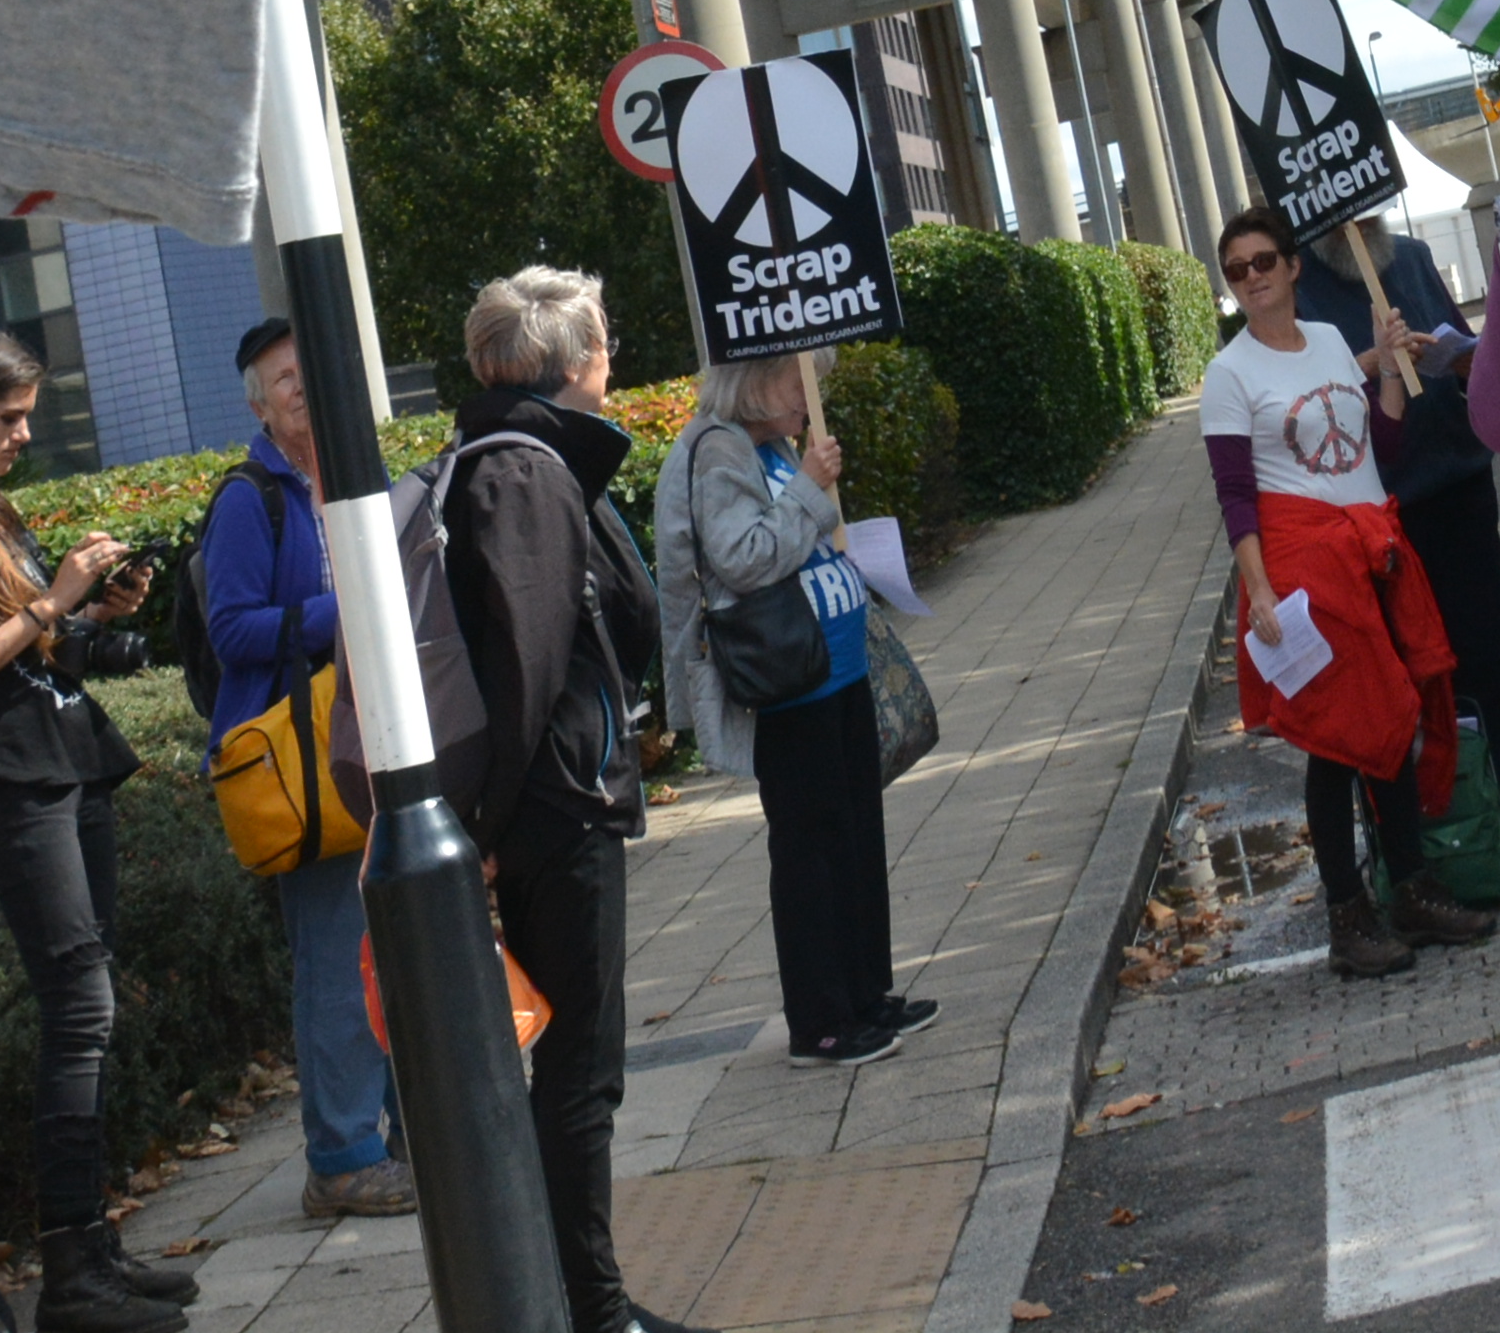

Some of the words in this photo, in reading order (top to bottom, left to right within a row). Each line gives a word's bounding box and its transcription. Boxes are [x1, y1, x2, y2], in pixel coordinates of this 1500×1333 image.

[623, 90, 666, 145] 2
[1278, 119, 1360, 184] Scrap
[1278, 145, 1391, 228] Trident
[727, 243, 852, 293] Scrap
[715, 274, 881, 339] Trident
[726, 343, 768, 359] CAMPAIGN
[769, 340, 785, 352] FOR
[785, 334, 824, 350] NUCLEAR
[825, 318, 884, 342] DISARMAMENT
